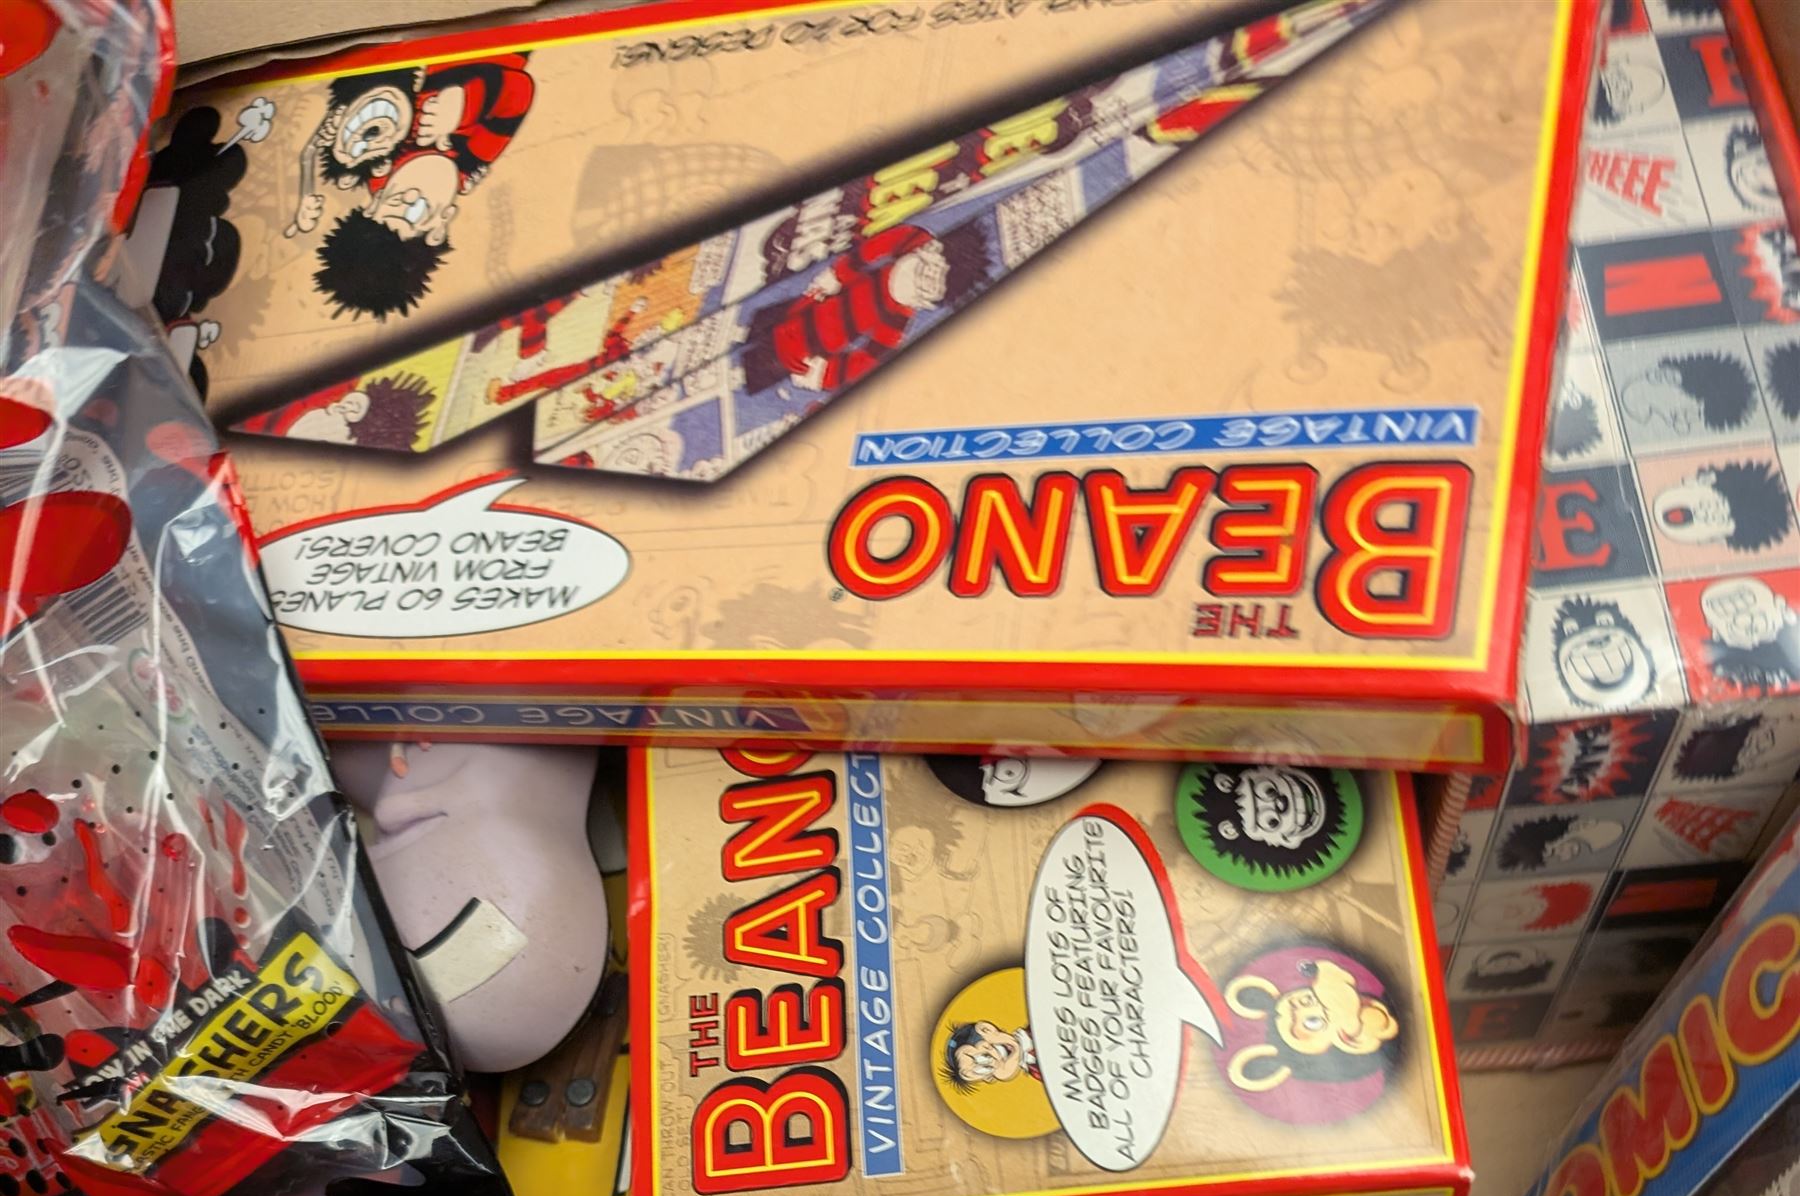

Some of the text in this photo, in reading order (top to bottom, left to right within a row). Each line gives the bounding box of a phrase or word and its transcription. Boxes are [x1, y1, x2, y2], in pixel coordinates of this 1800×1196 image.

[858, 409, 1468, 464] VINTAGE COLLECTION
[295, 527, 571, 561] BEANO COVERS!
[306, 558, 554, 586] FROM VINTAGE
[828, 460, 1474, 641] BEANO
[270, 584, 580, 614] MAKES 60 PLANES
[1193, 602, 1302, 640] THE
[314, 703, 780, 730] VINTAGE COLLE
[691, 749, 854, 1196] BEAN
[850, 752, 898, 1155] VINTAGE COLLECT
[1044, 886, 1085, 1103] MAKES LOTS OF
[1063, 855, 1110, 1131] BADGES FEATURING
[1082, 820, 1137, 1164] ALL OF YOUR FAVOURITE
[1113, 889, 1153, 1079] CHARACTERS!
[130, 1040, 153, 1063] IN
[190, 970, 251, 1016] DARK
[249, 1030, 293, 1068] CANDY
[690, 991, 721, 1078] THE
